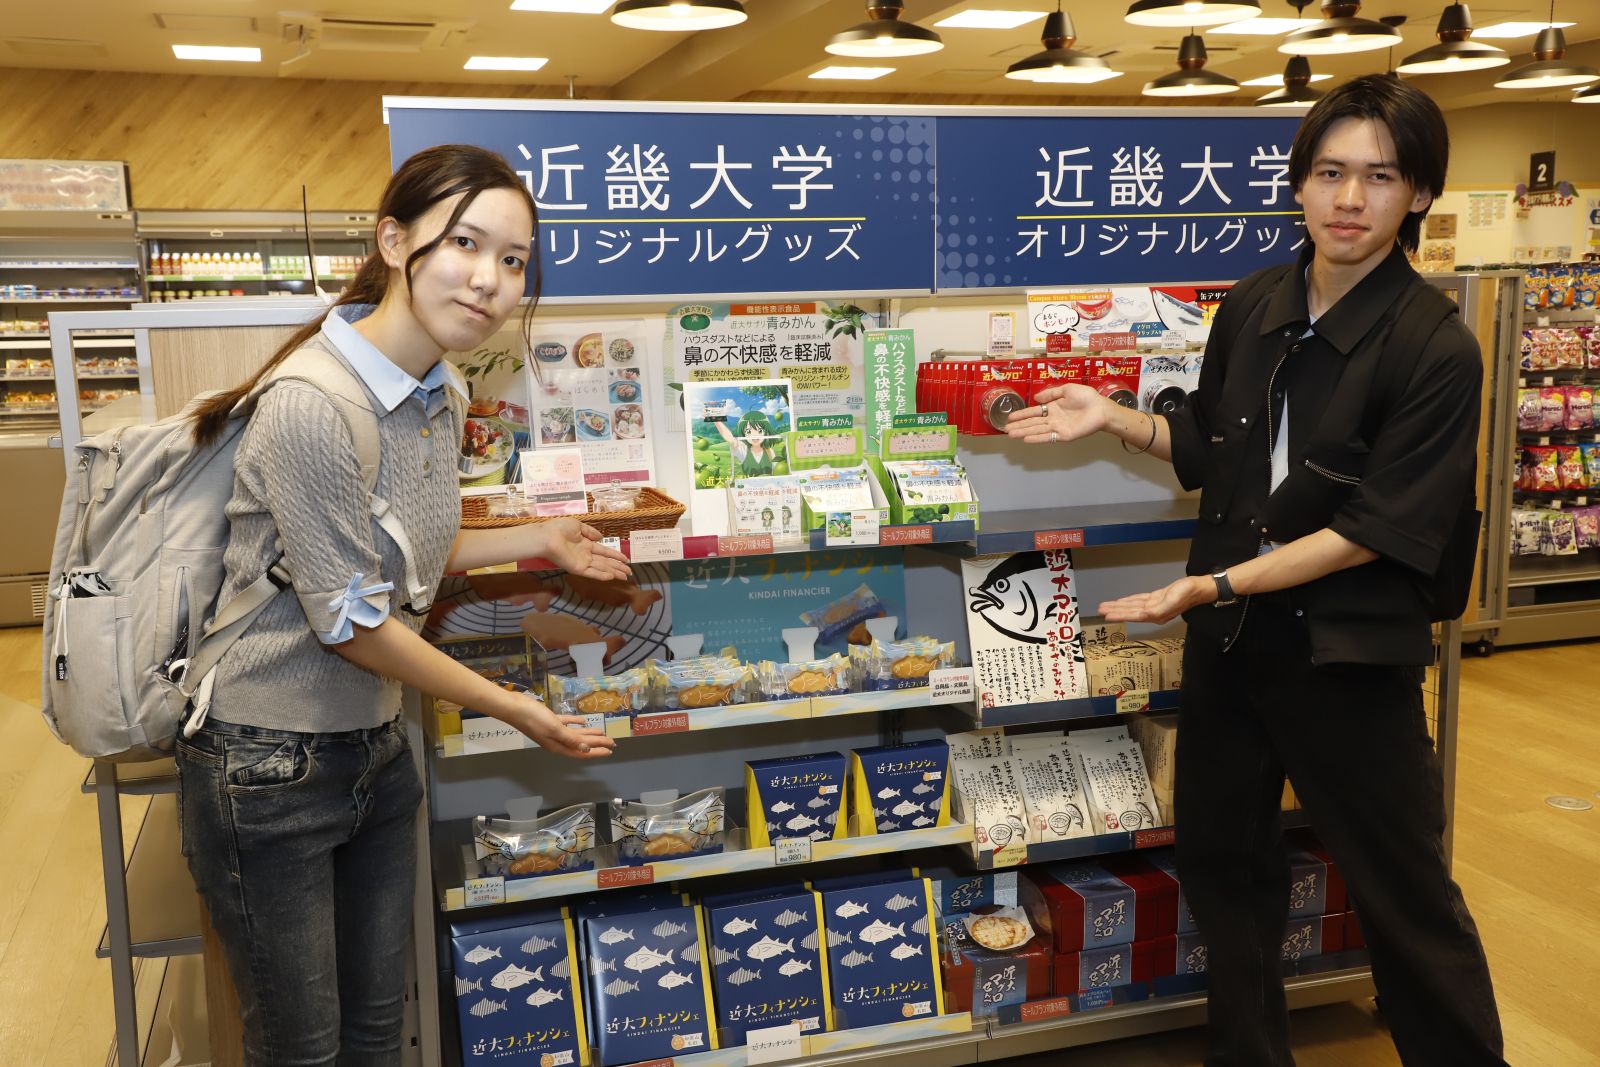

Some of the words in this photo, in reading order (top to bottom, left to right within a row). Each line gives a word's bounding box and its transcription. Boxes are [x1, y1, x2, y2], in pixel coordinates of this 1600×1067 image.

[516, 143, 834, 211] 近畿大学
[1537, 163, 1547, 182] 2
[532, 224, 862, 265] リジナルグッズ
[746, 305, 801, 313] 機能性表示食品
[767, 316, 816, 331] 青みかん
[683, 333, 776, 344] ハウスダストなどによる
[684, 342, 832, 366] 鼻の不快感を軽減
[781, 366, 848, 375] 青みかんに含まれる成分
[822, 417, 852, 427] 青みかん
[917, 415, 947, 425] 青みかん
[749, 588, 780, 600] KINDAI
[783, 586, 831, 597] FINANCIER
[1045, 549, 1074, 640] 近大マグロ
[1046, 630, 1066, 701] あおさのみそ汁
[877, 759, 937, 774] 近大フィナンシェ
[770, 772, 833, 788] 近大フィナンシェ
[842, 980, 930, 1003] 近大フィナンシェ
[729, 995, 818, 1021] 近大フィナンシェ
[606, 1010, 700, 1034] 近大フィナンシェ
[471, 1027, 571, 1057] 近大フィナンシェ
